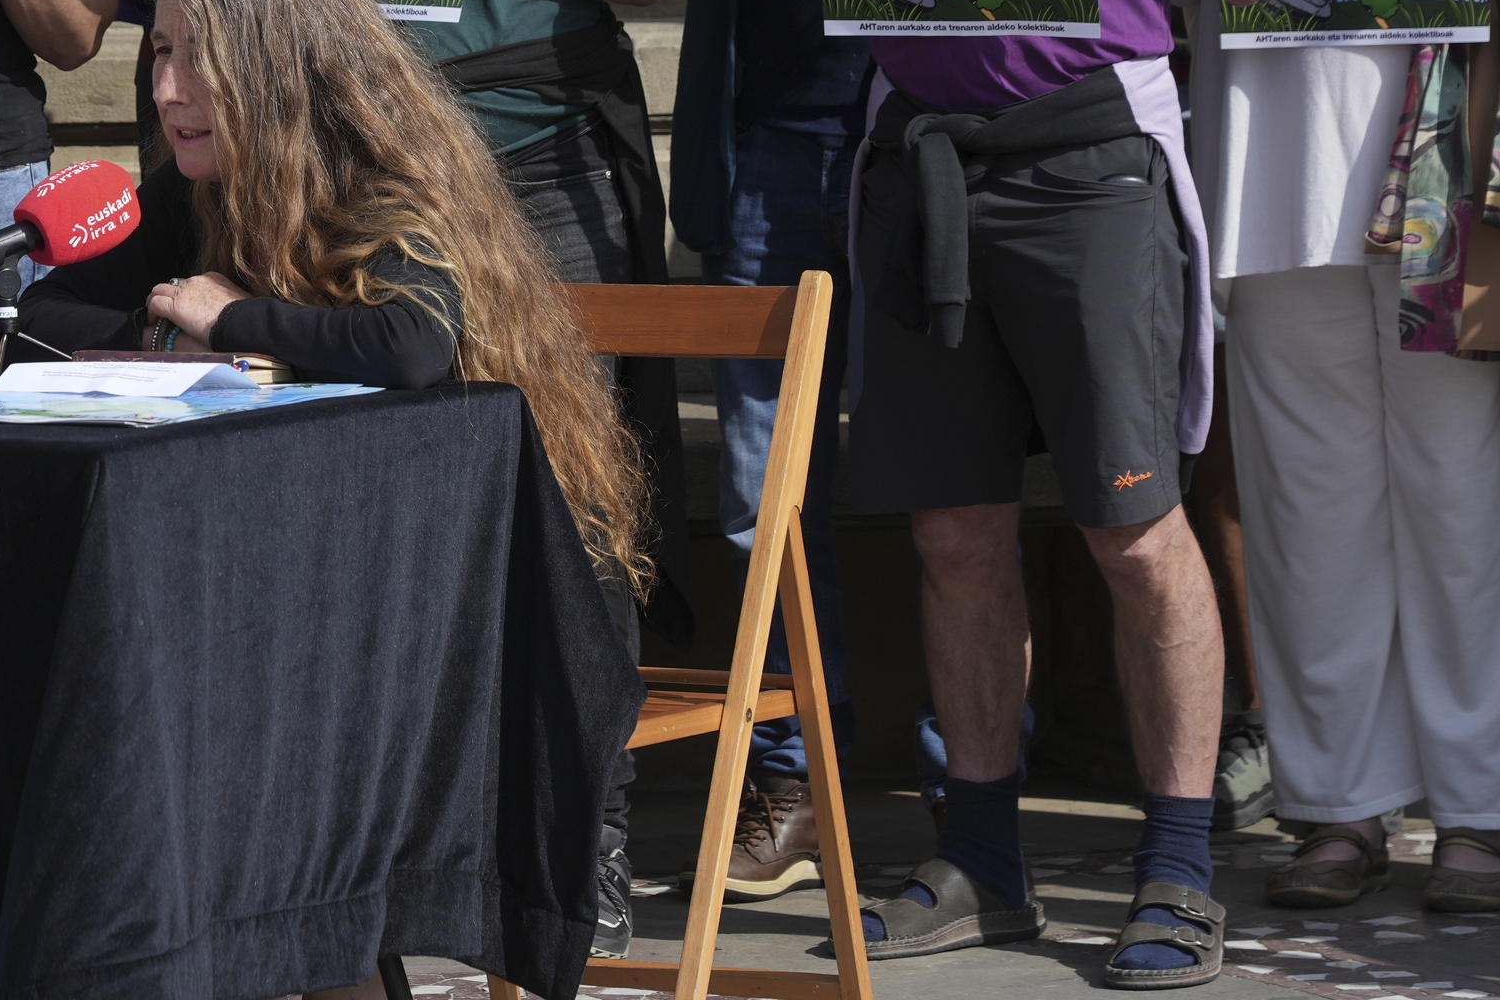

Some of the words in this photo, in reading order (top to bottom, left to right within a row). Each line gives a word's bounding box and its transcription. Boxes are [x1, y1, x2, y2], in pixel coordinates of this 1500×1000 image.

[859, 23, 895, 31] AHTaren
[987, 23, 1016, 31] aldeko
[1017, 23, 1065, 32] kolektiboak
[86, 187, 132, 226] euskadi
[90, 210, 131, 240] irraia
